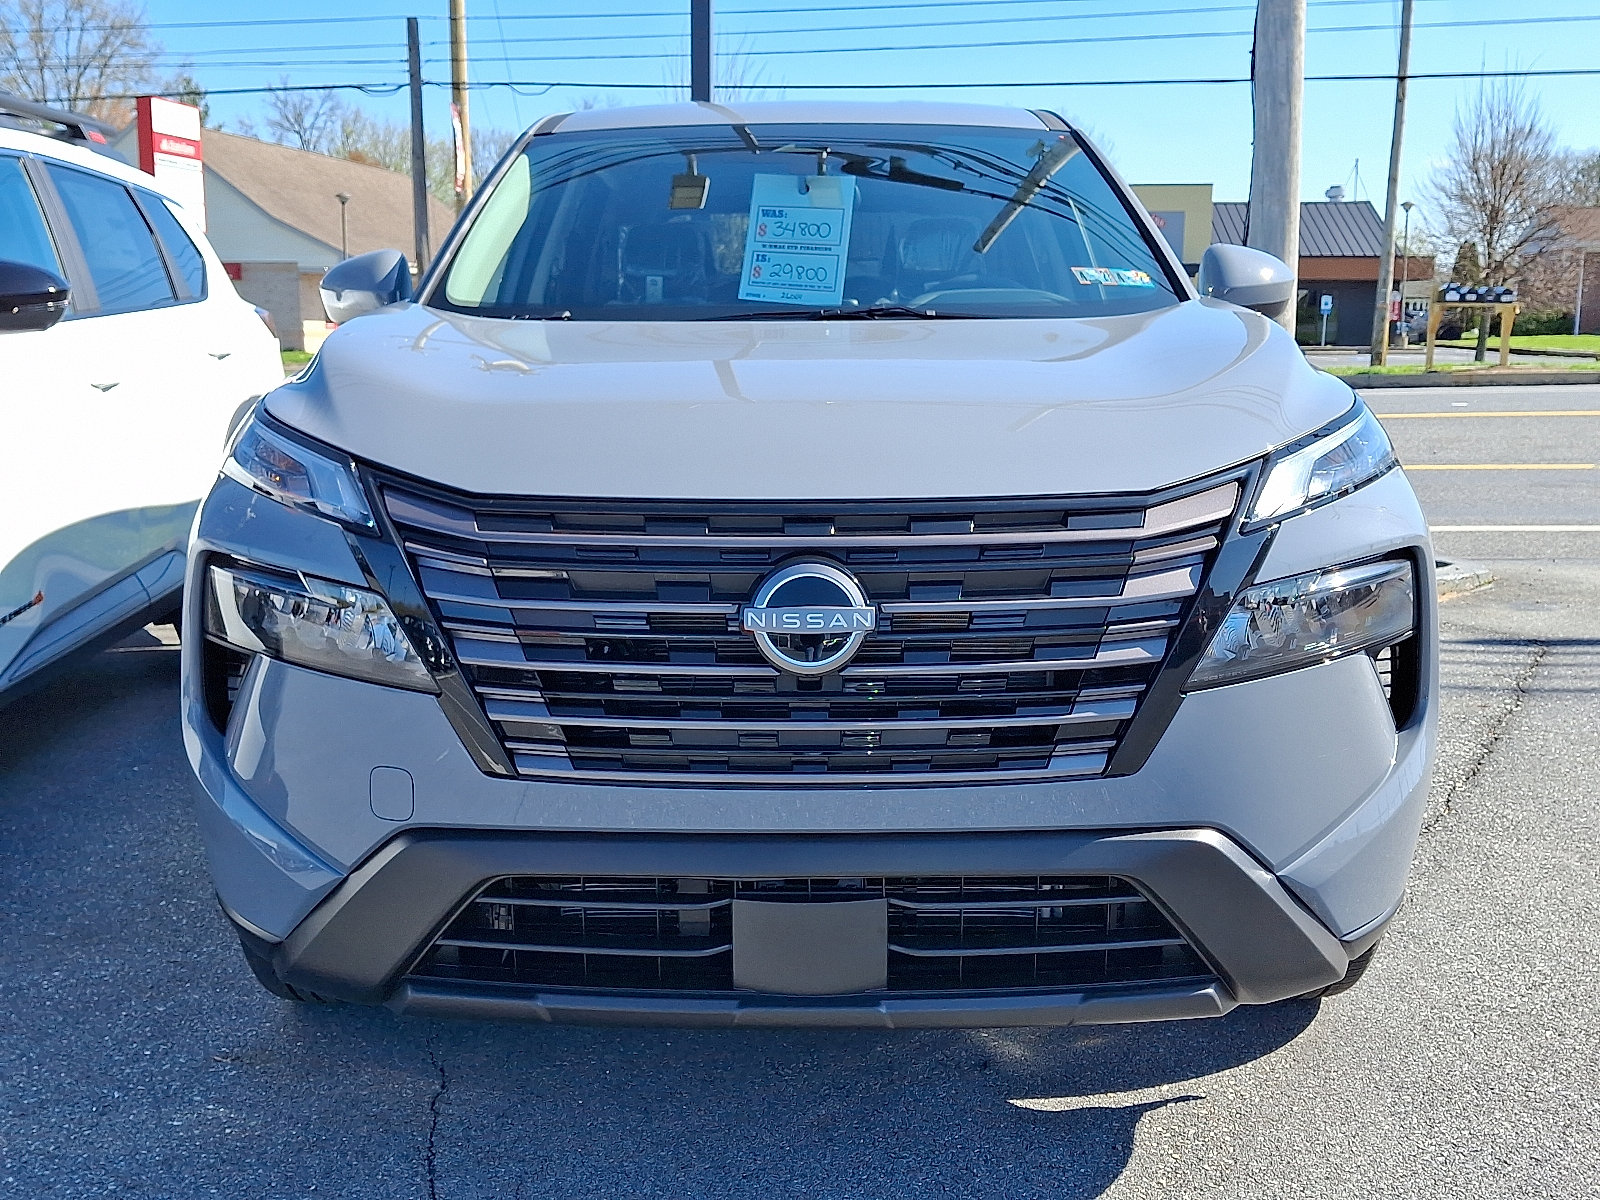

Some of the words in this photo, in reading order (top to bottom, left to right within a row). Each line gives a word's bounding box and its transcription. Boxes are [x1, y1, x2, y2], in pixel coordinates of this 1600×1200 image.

[761, 209, 788, 218] WAS:
[757, 222, 767, 236] $
[772, 221, 831, 238] 34800
[755, 254, 771, 263] IS:
[752, 265, 762, 279] $
[769, 263, 827, 282] 29800
[747, 612, 871, 628] NISSAN
